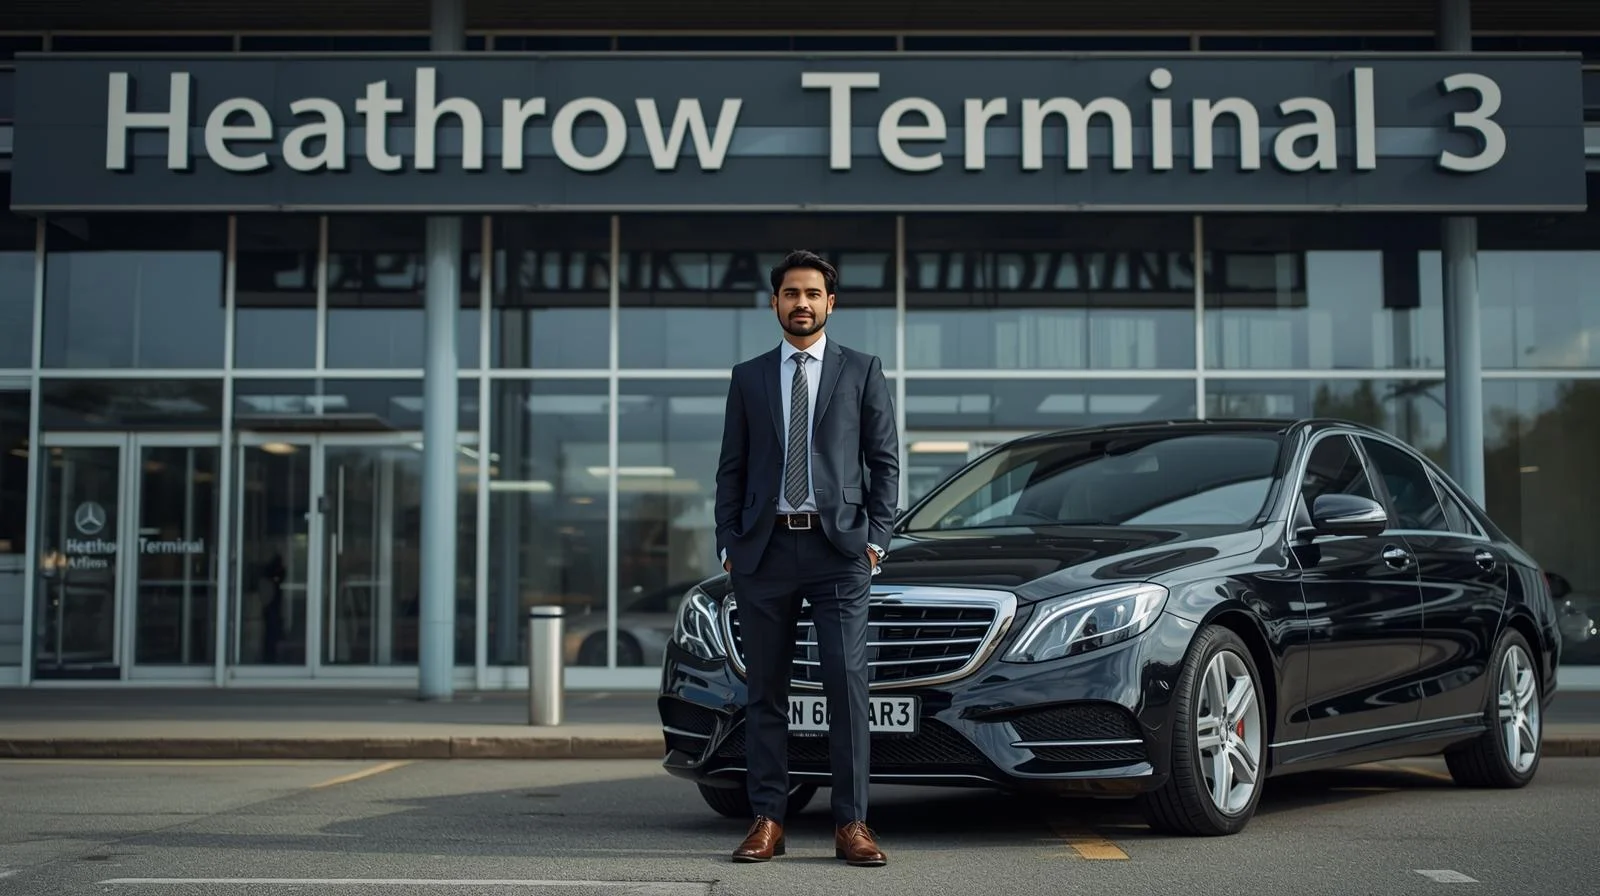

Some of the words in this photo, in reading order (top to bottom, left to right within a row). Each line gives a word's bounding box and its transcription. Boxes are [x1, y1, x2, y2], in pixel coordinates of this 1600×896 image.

[106, 68, 742, 171] Heathrow
[801, 67, 1377, 170] Terminal
[1440, 74, 1506, 171] 3
[139, 538, 204, 553] Terminal
[787, 701, 804, 725] N
